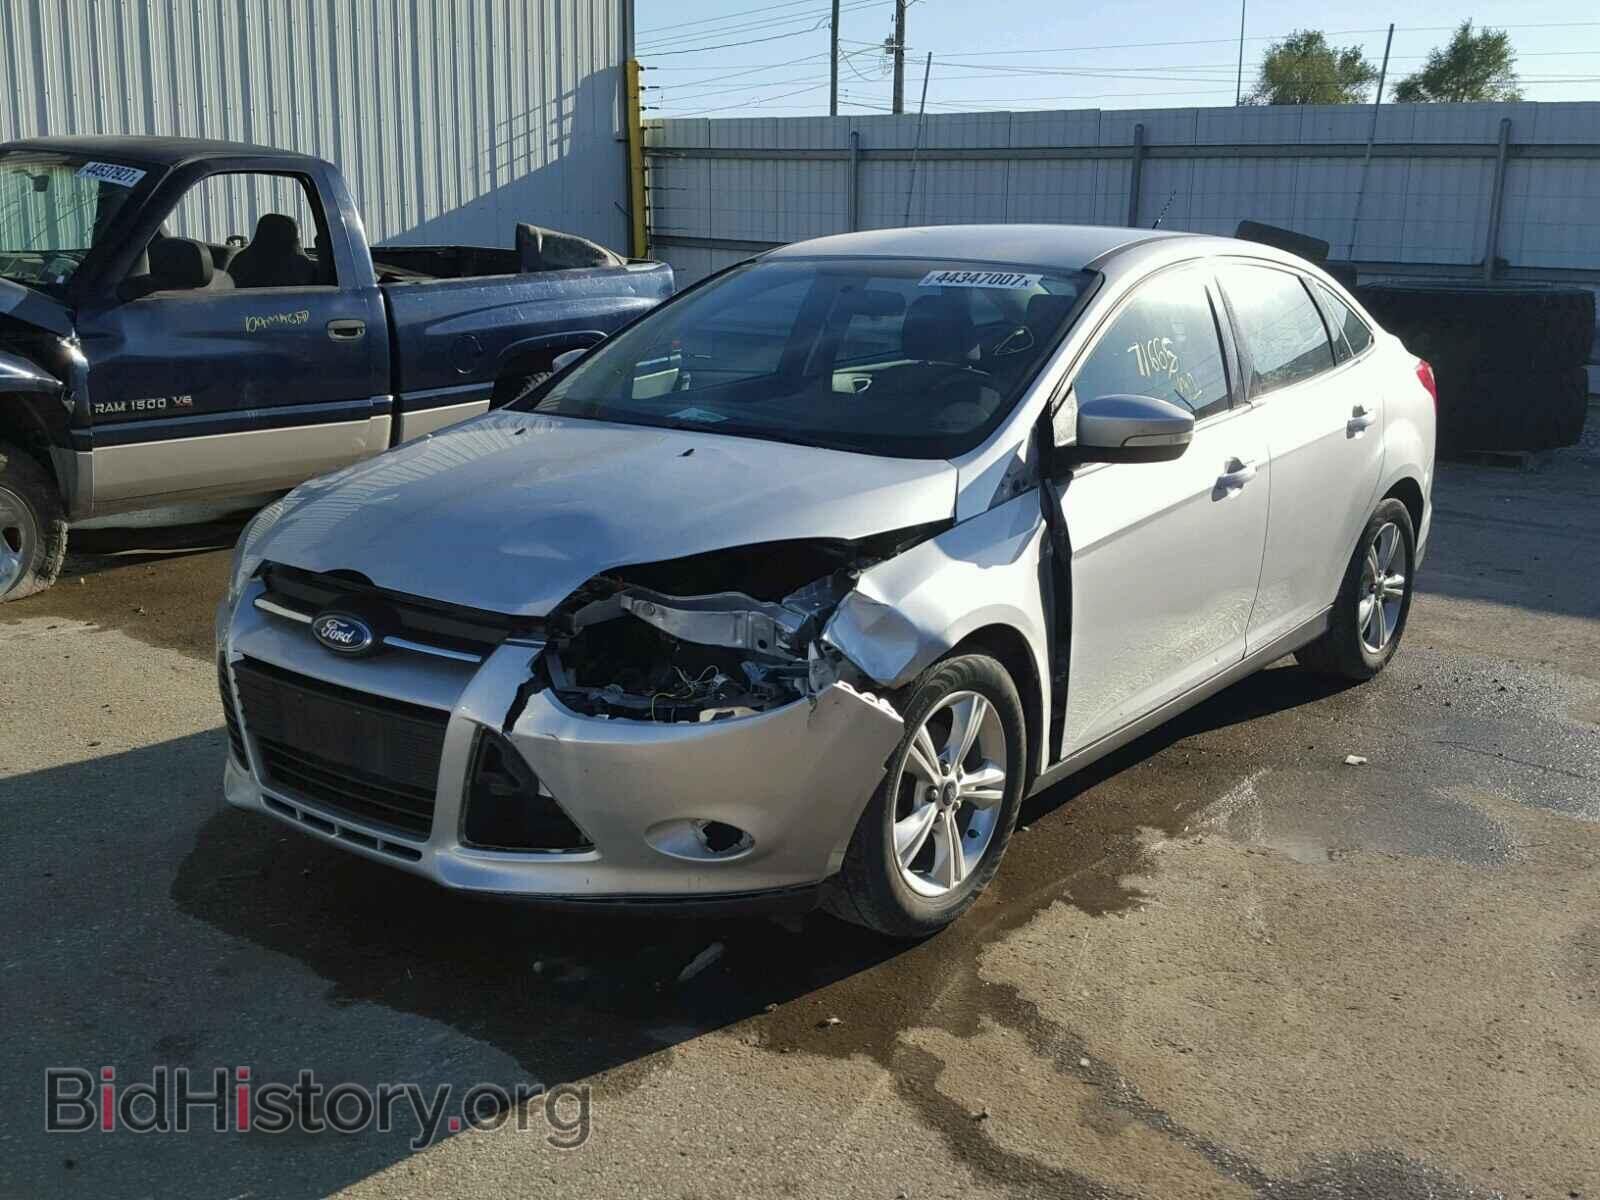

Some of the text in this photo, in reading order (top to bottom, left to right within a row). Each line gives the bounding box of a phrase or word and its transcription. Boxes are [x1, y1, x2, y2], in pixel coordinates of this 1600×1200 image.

[935, 270, 1026, 287] 44347007
[95, 402, 127, 414] RAM
[131, 398, 167, 411] 1500
[320, 619, 355, 643] Ford
